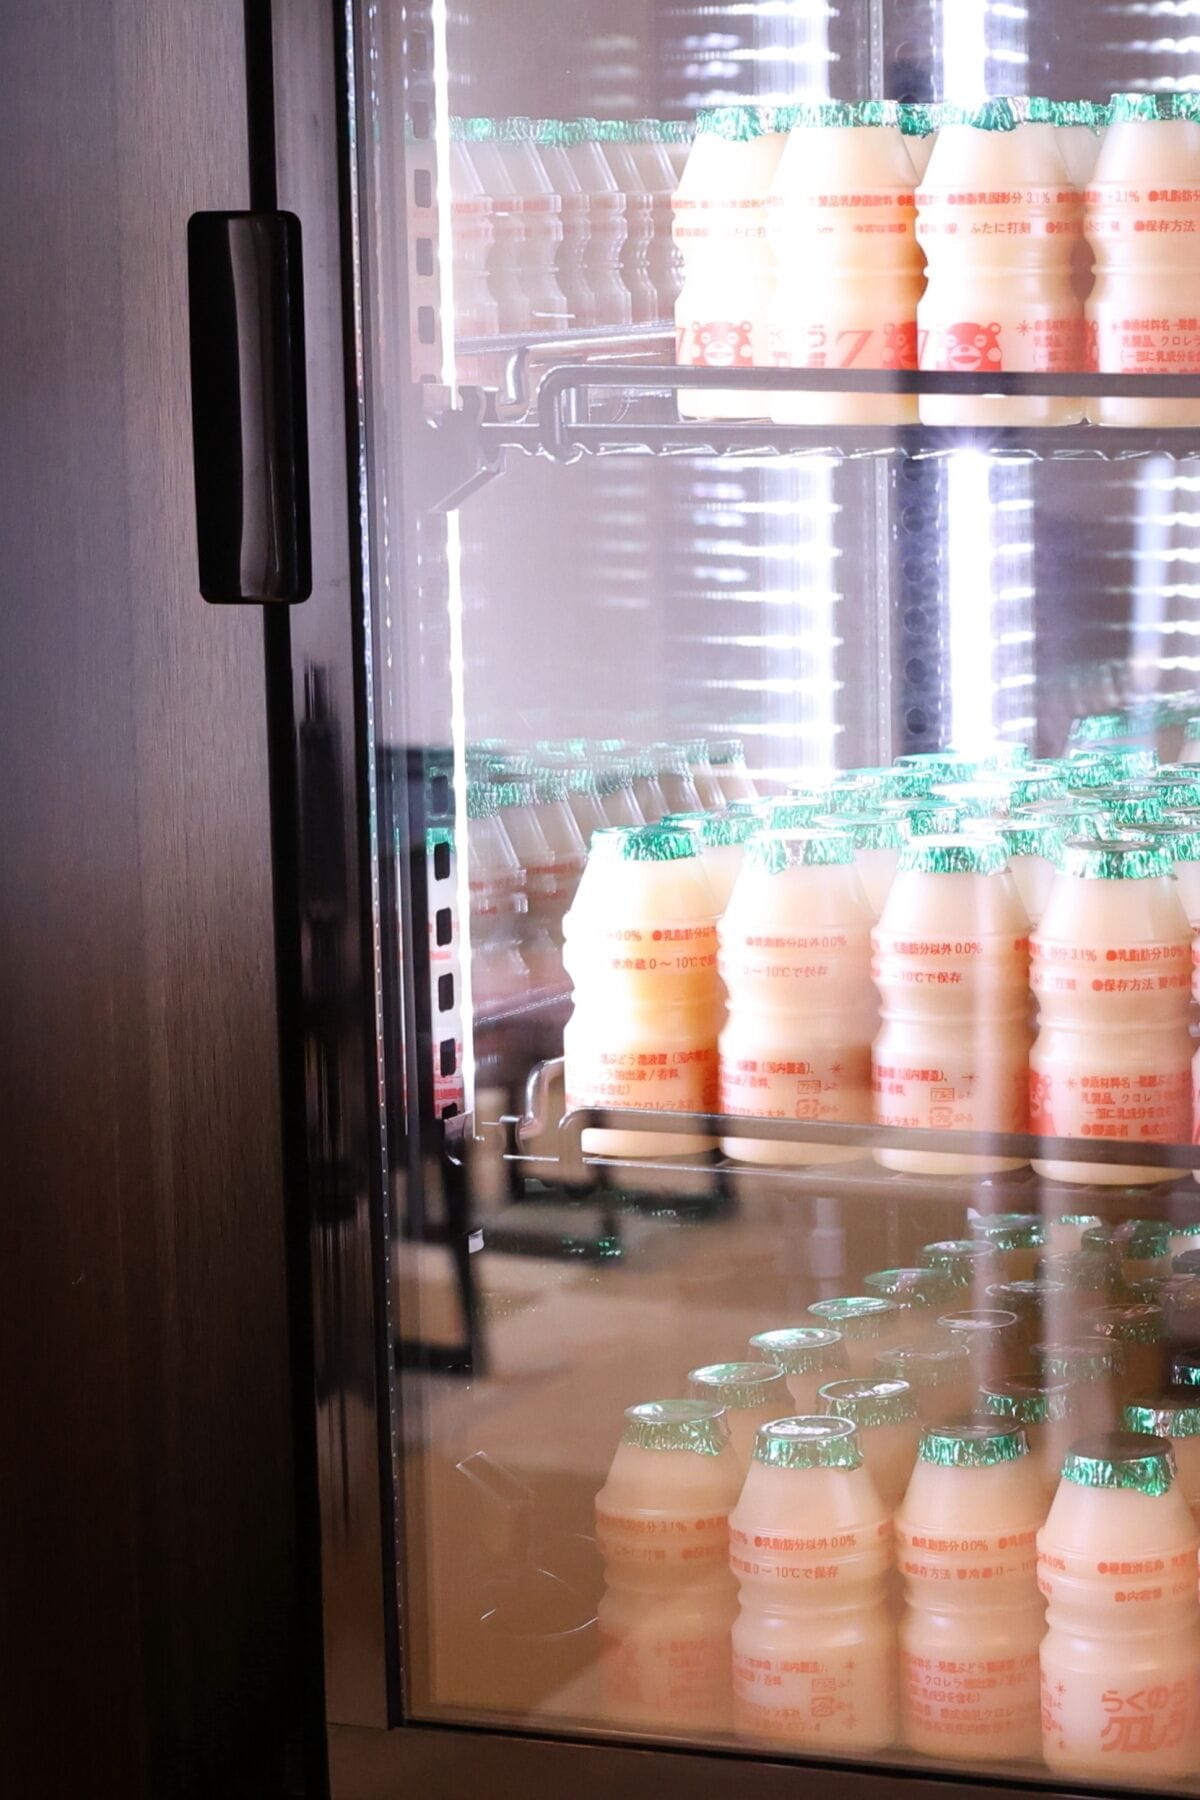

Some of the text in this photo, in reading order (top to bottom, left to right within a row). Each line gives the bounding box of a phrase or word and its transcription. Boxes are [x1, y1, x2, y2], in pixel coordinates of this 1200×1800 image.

[762, 1536, 829, 1551] 乳脂肪分以外
